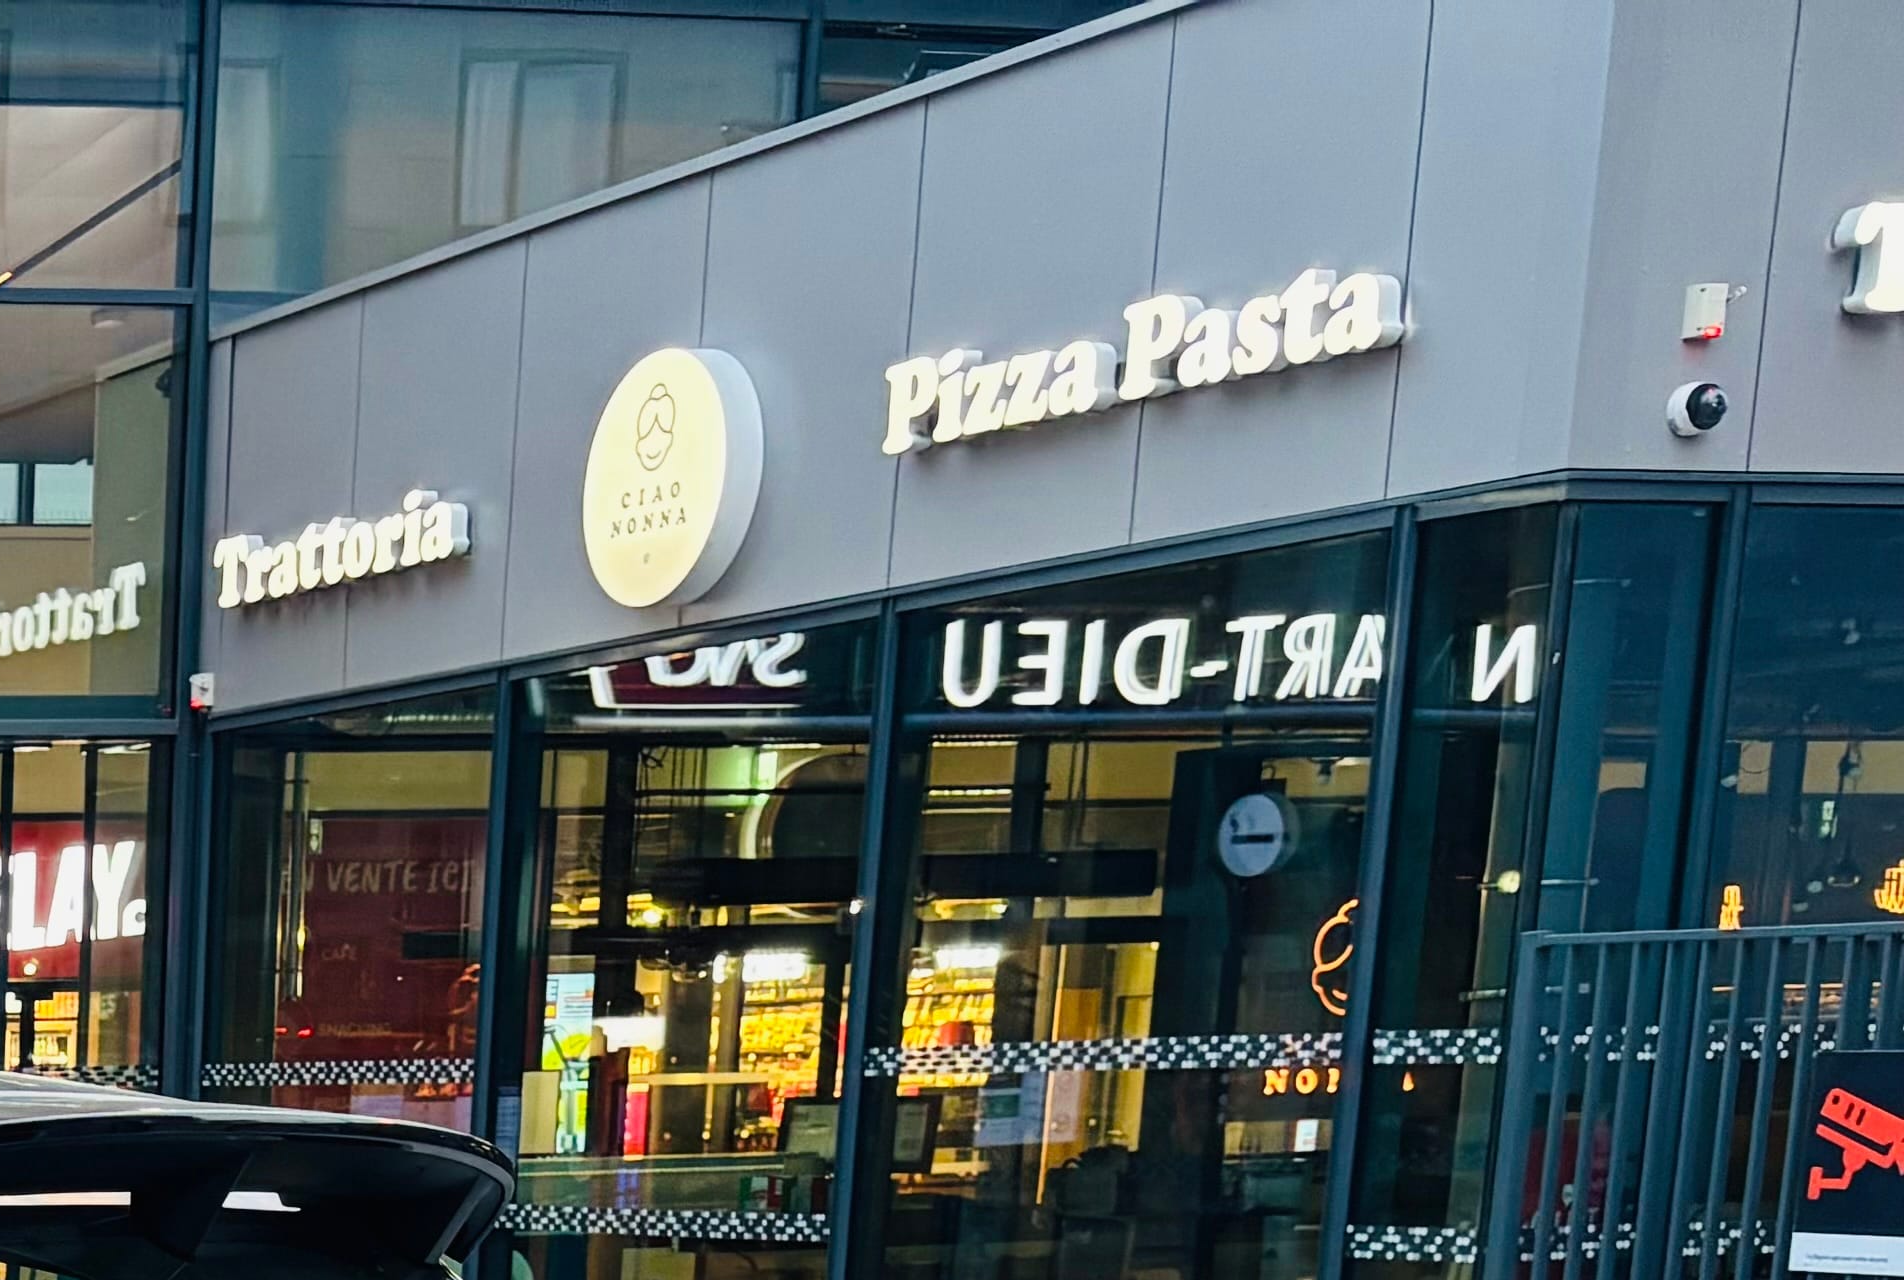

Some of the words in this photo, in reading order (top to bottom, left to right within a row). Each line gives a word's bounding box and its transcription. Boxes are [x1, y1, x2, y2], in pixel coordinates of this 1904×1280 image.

[882, 338, 1117, 455] Pizza
[1118, 268, 1402, 402] Pasta
[621, 481, 681, 509] CIAO
[610, 507, 687, 538] NONNA
[213, 487, 470, 609] Trattoria
[326, 859, 419, 893] VENTE
